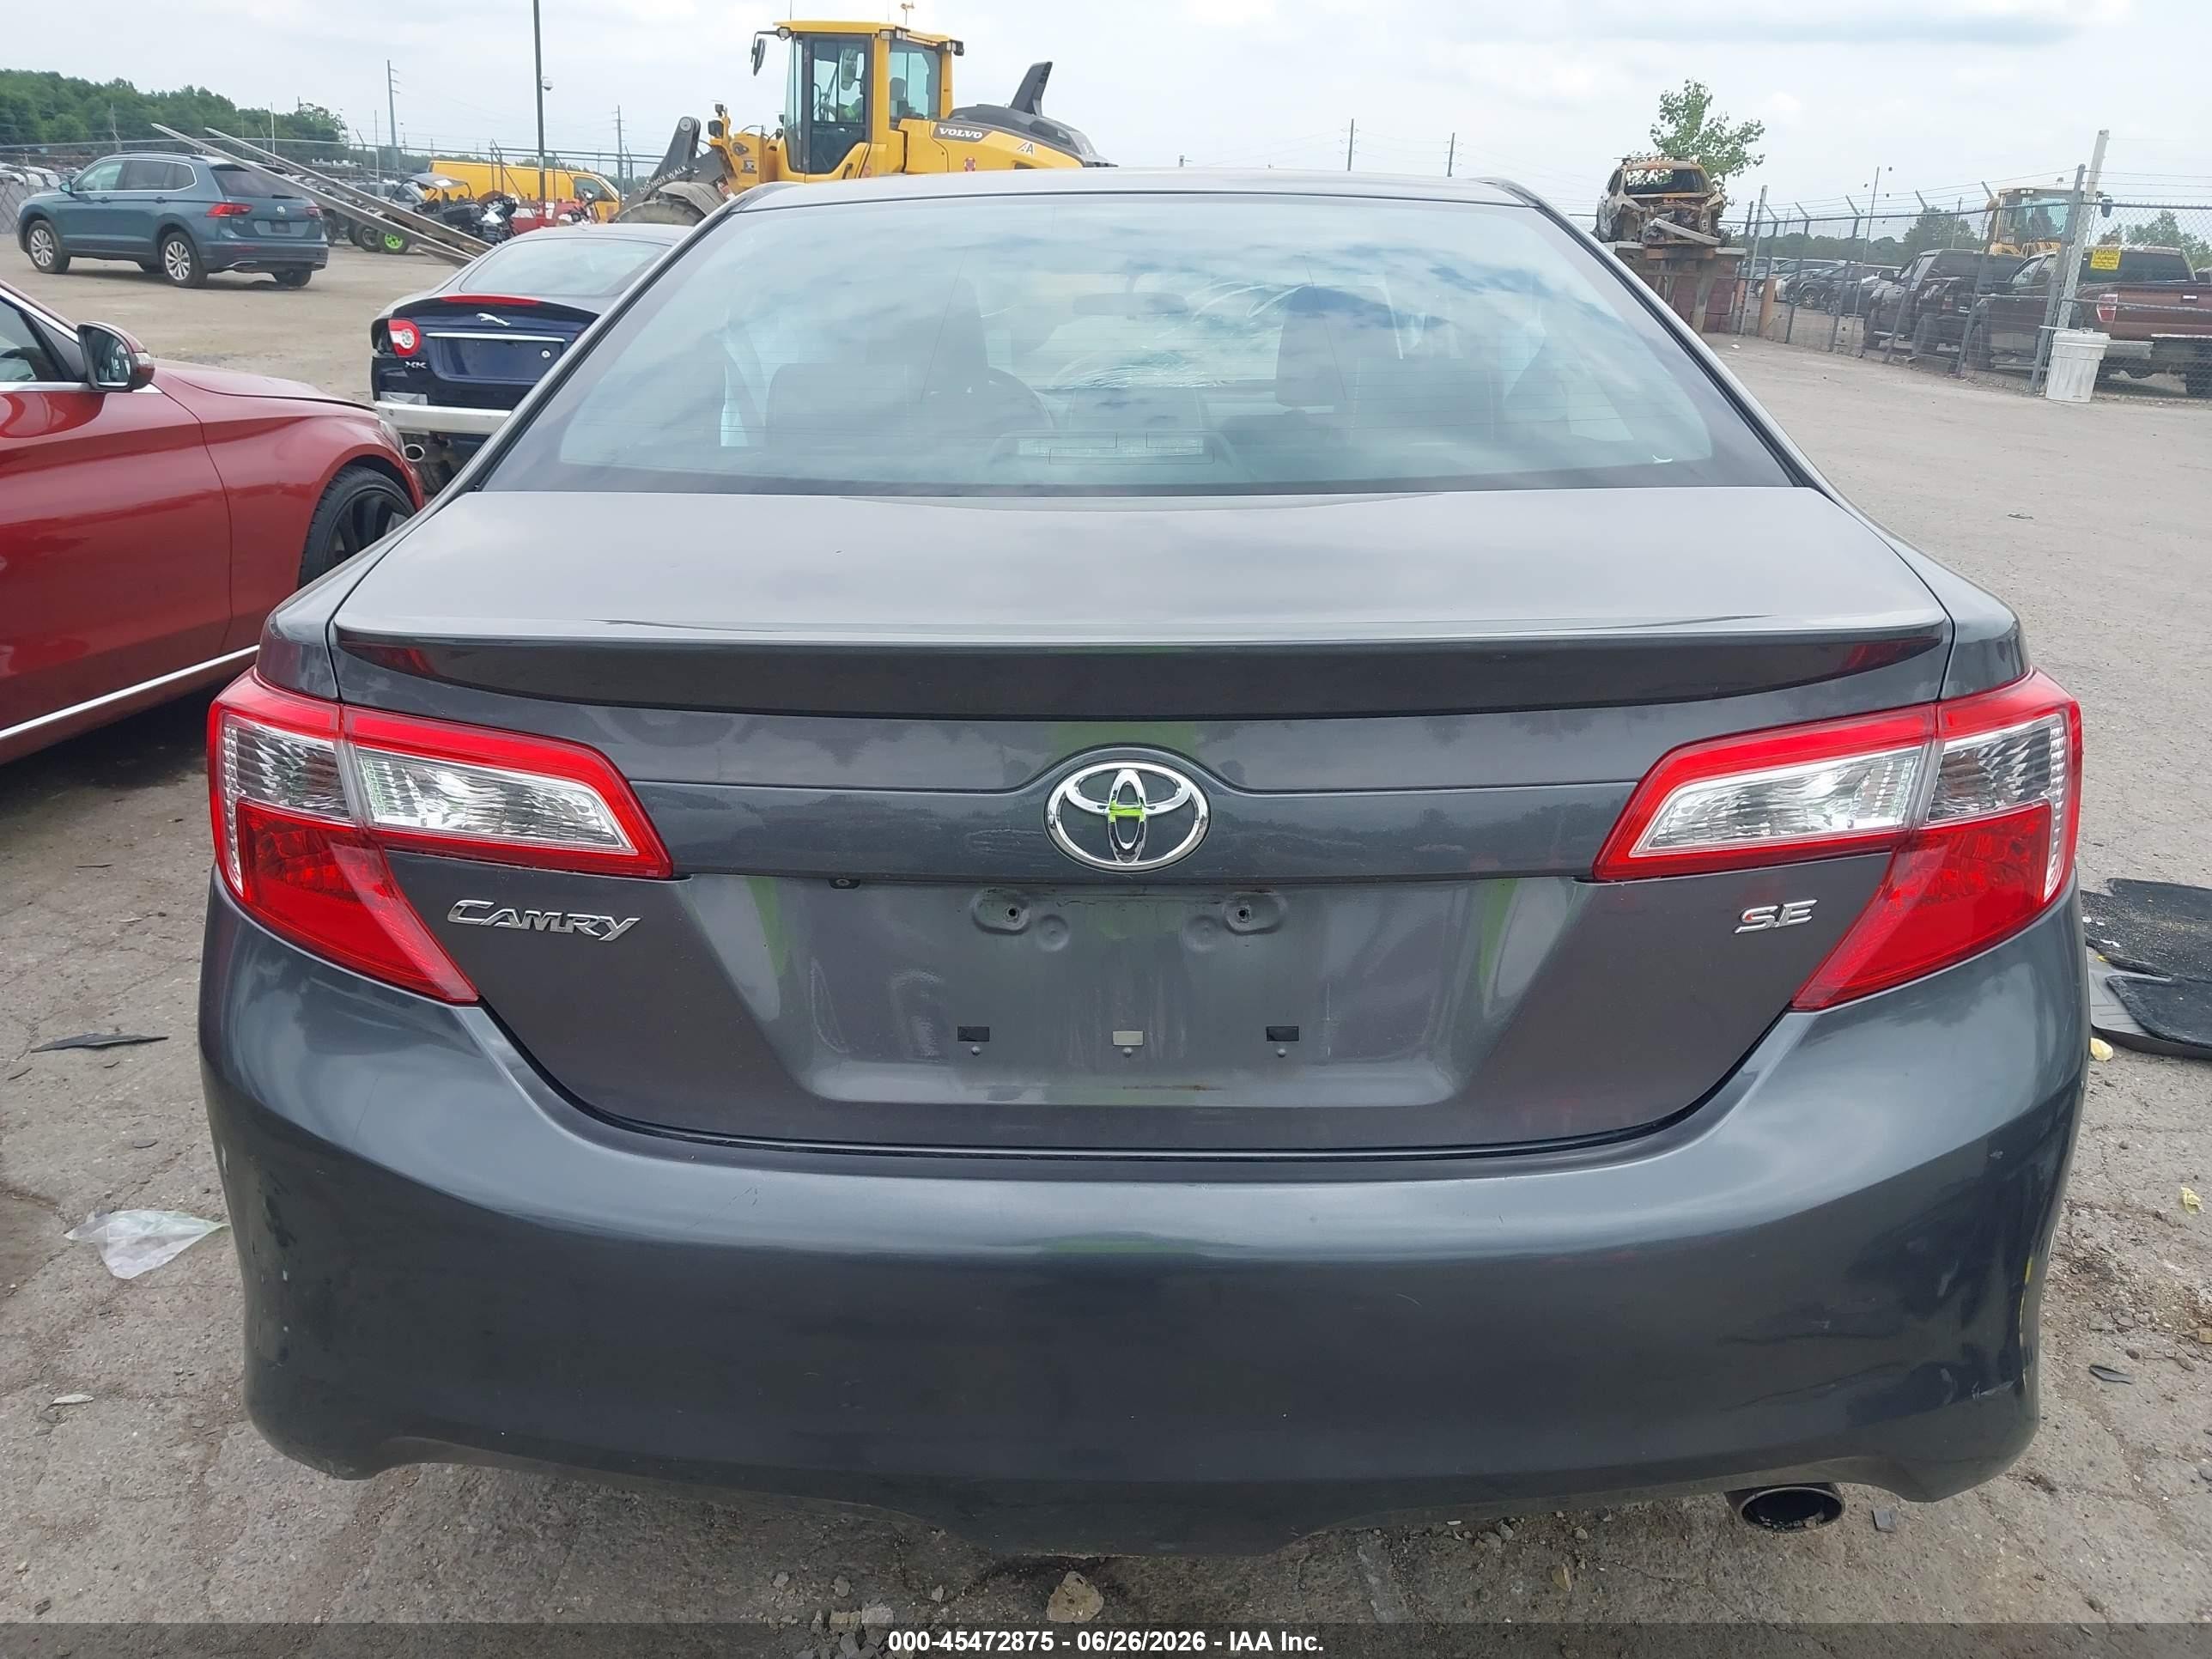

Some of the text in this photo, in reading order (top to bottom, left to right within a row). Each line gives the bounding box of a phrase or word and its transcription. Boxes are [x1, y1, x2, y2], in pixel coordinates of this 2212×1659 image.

[939, 127, 982, 138] VOLVO
[639, 165, 688, 194] DO NOT WALK
[1734, 898, 1819, 934] SE
